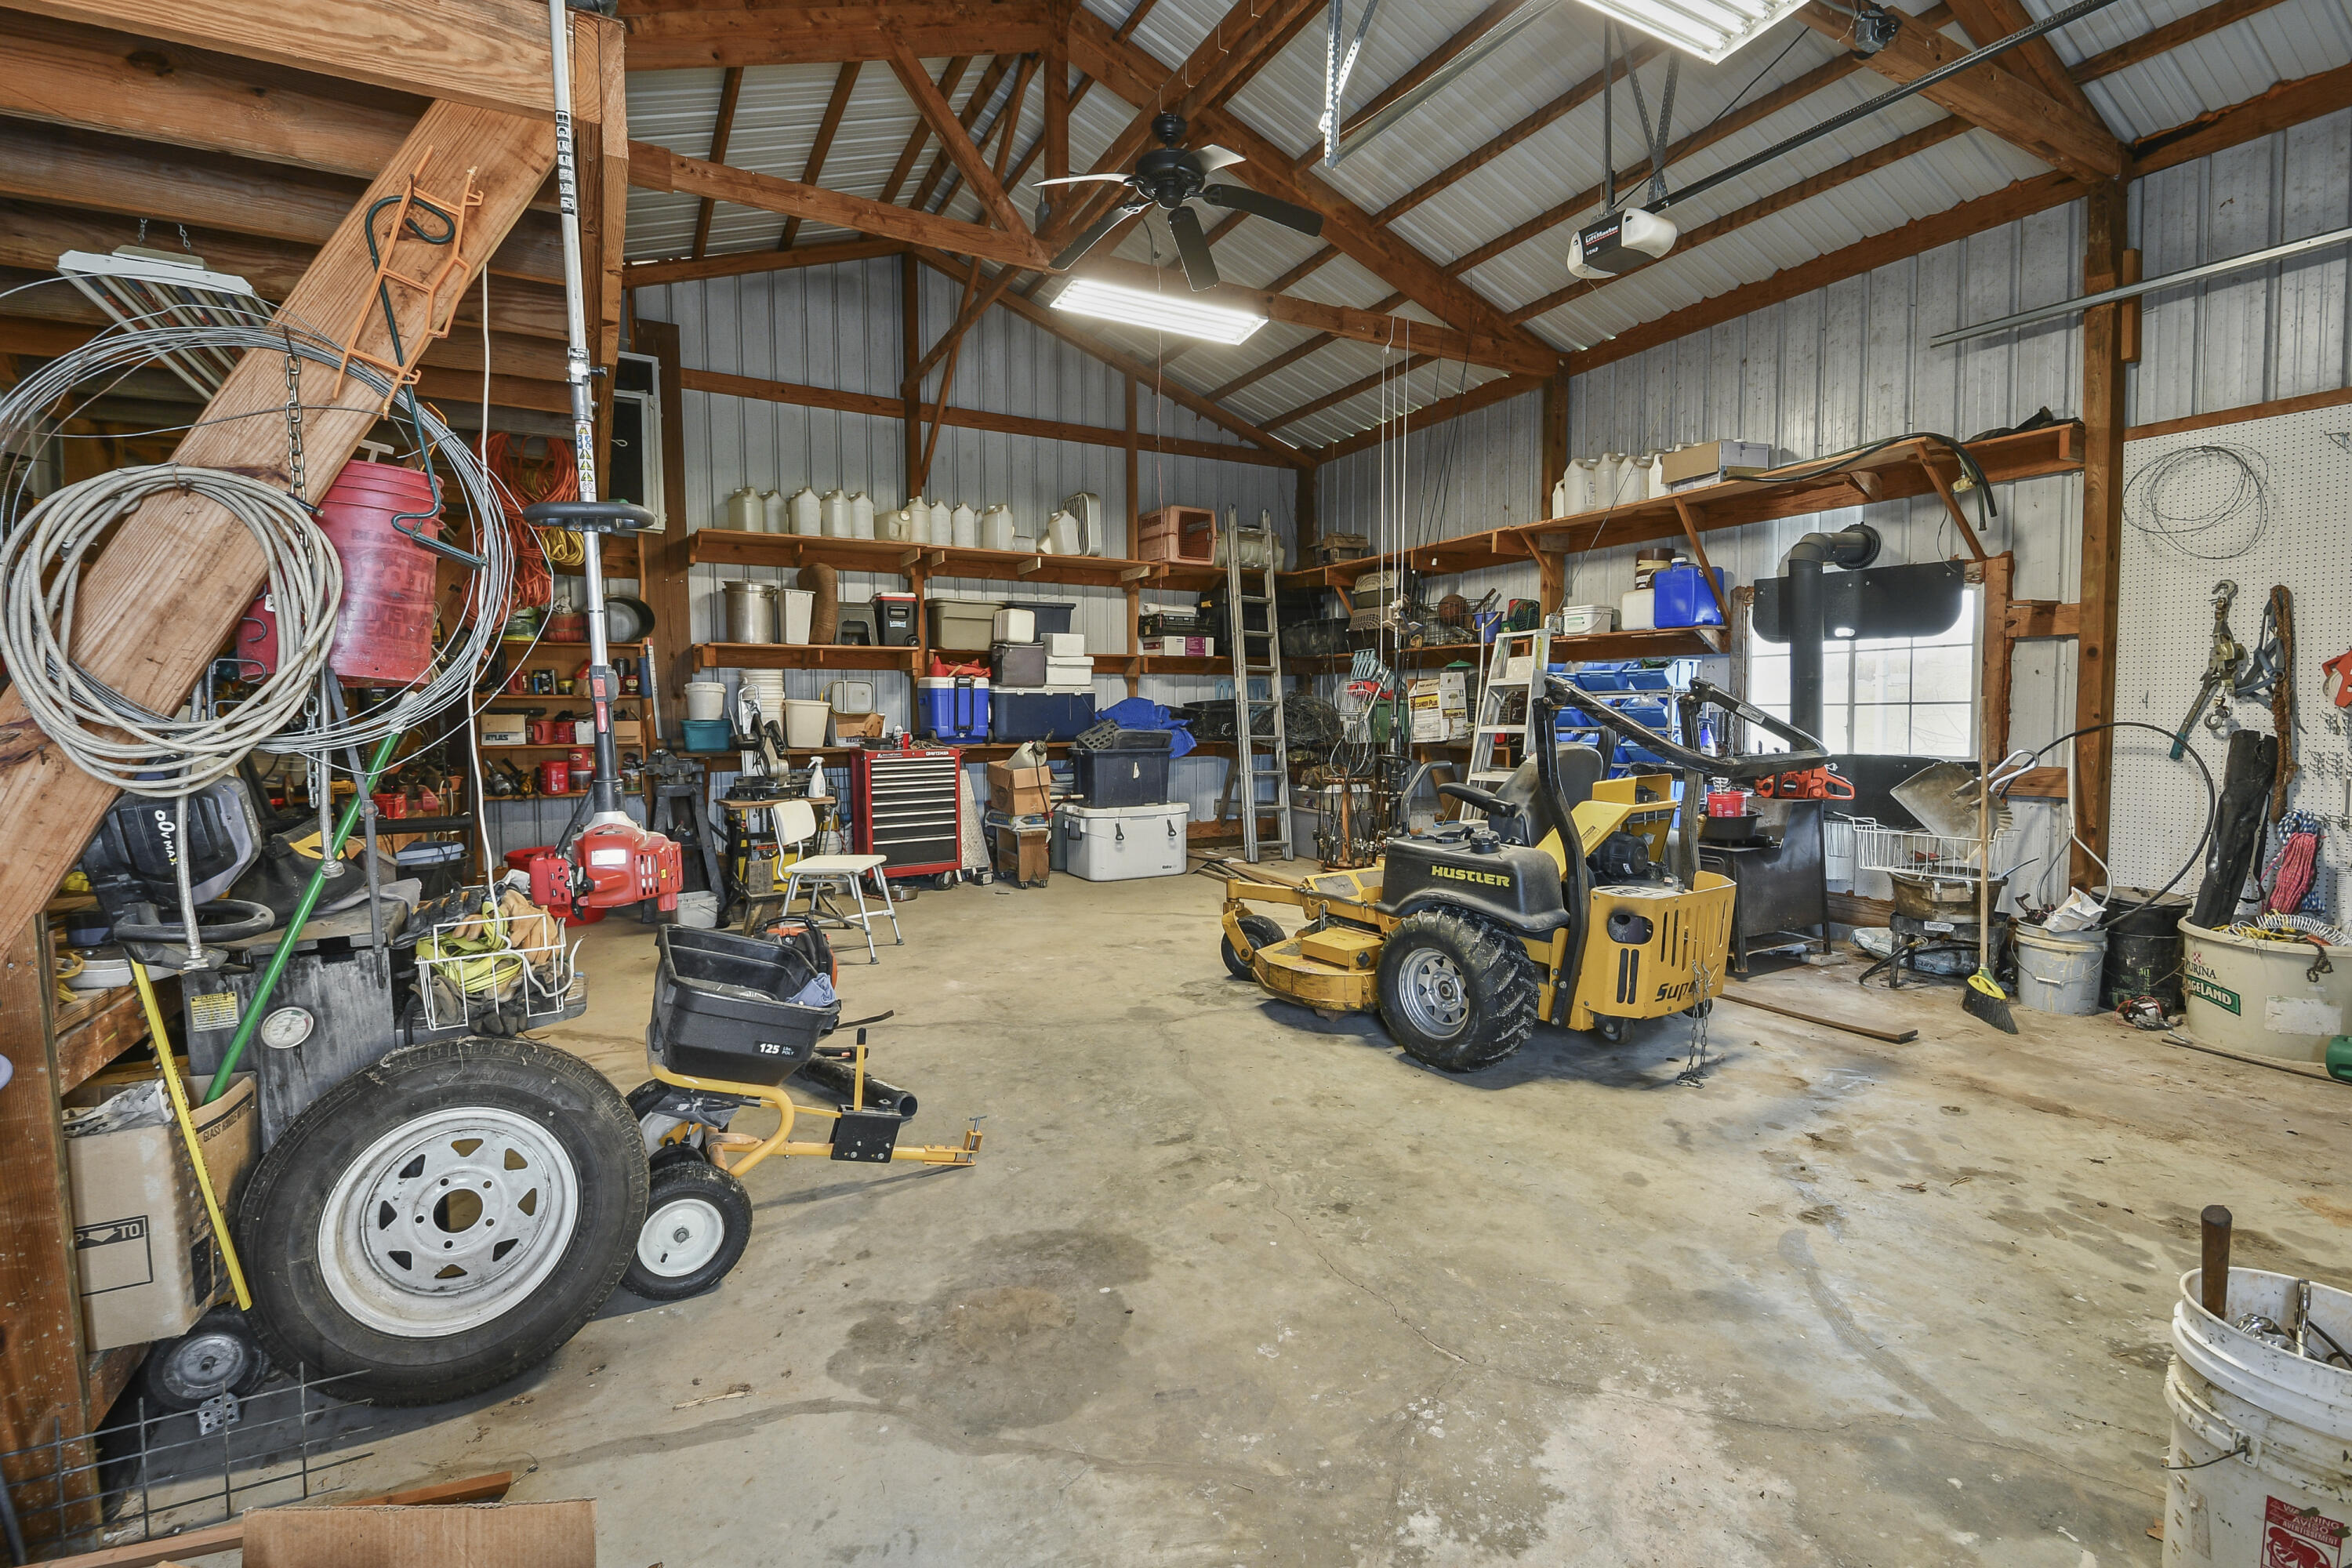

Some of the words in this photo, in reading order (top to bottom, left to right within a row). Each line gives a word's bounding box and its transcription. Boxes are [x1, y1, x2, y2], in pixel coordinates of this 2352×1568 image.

[1432, 865, 1511, 887] HUSTLER
[2185, 960, 2217, 979] PURINA
[760, 1043, 780, 1054] 125
[204, 1125, 221, 1142] GLASS
[119, 1223, 141, 1239] TO
[2282, 1520, 2338, 1545] AVERTISSEMENT
[2292, 1517, 2328, 1534] AVISO
